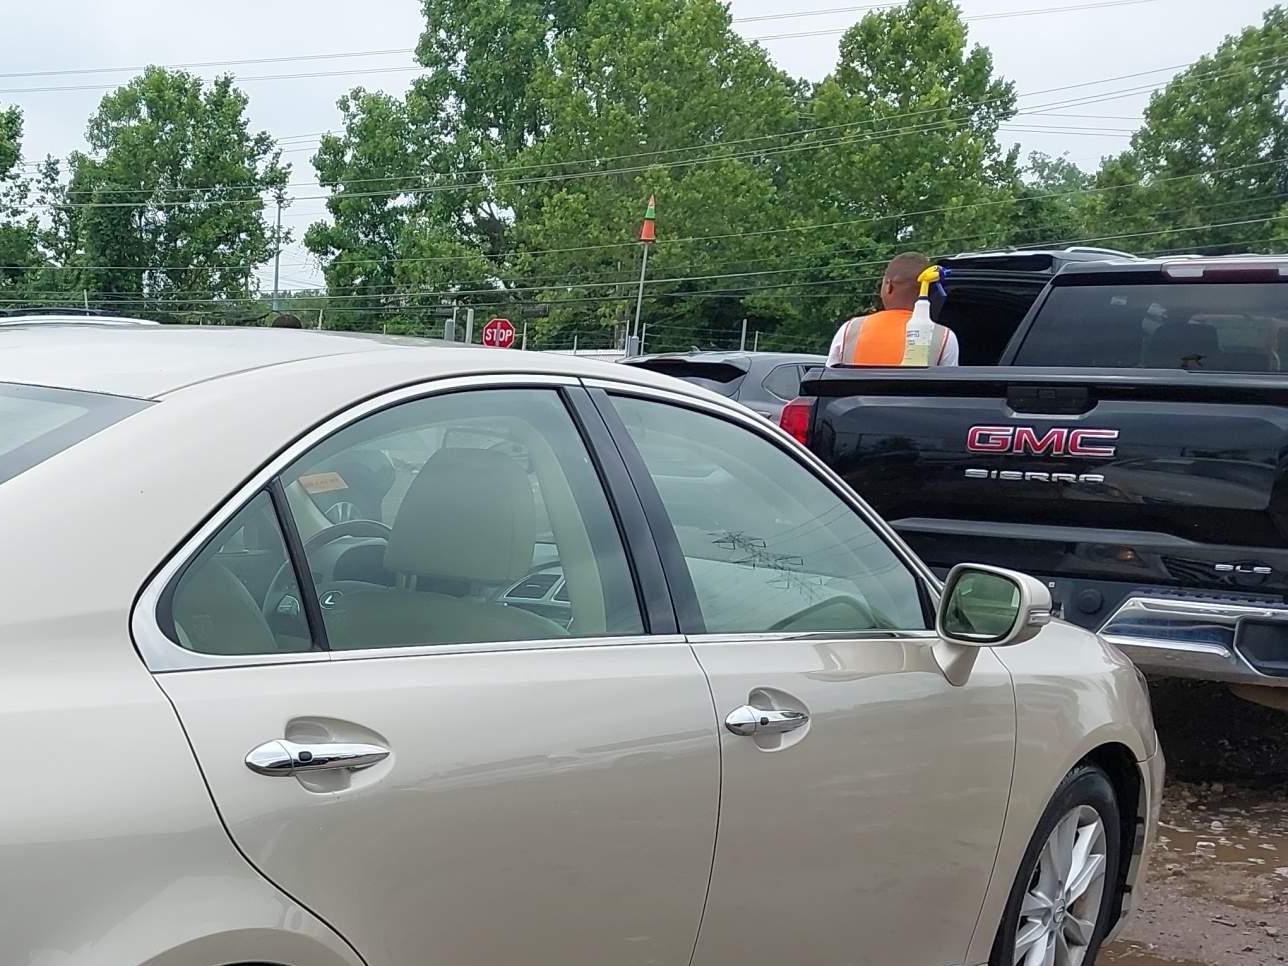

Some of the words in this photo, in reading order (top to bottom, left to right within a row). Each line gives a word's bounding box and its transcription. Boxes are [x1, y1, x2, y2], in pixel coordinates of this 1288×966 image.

[485, 328, 513, 342] STOP
[967, 426, 1119, 456] GMC
[964, 468, 1105, 483] SIERRA
[1215, 564, 1272, 574] SLE
